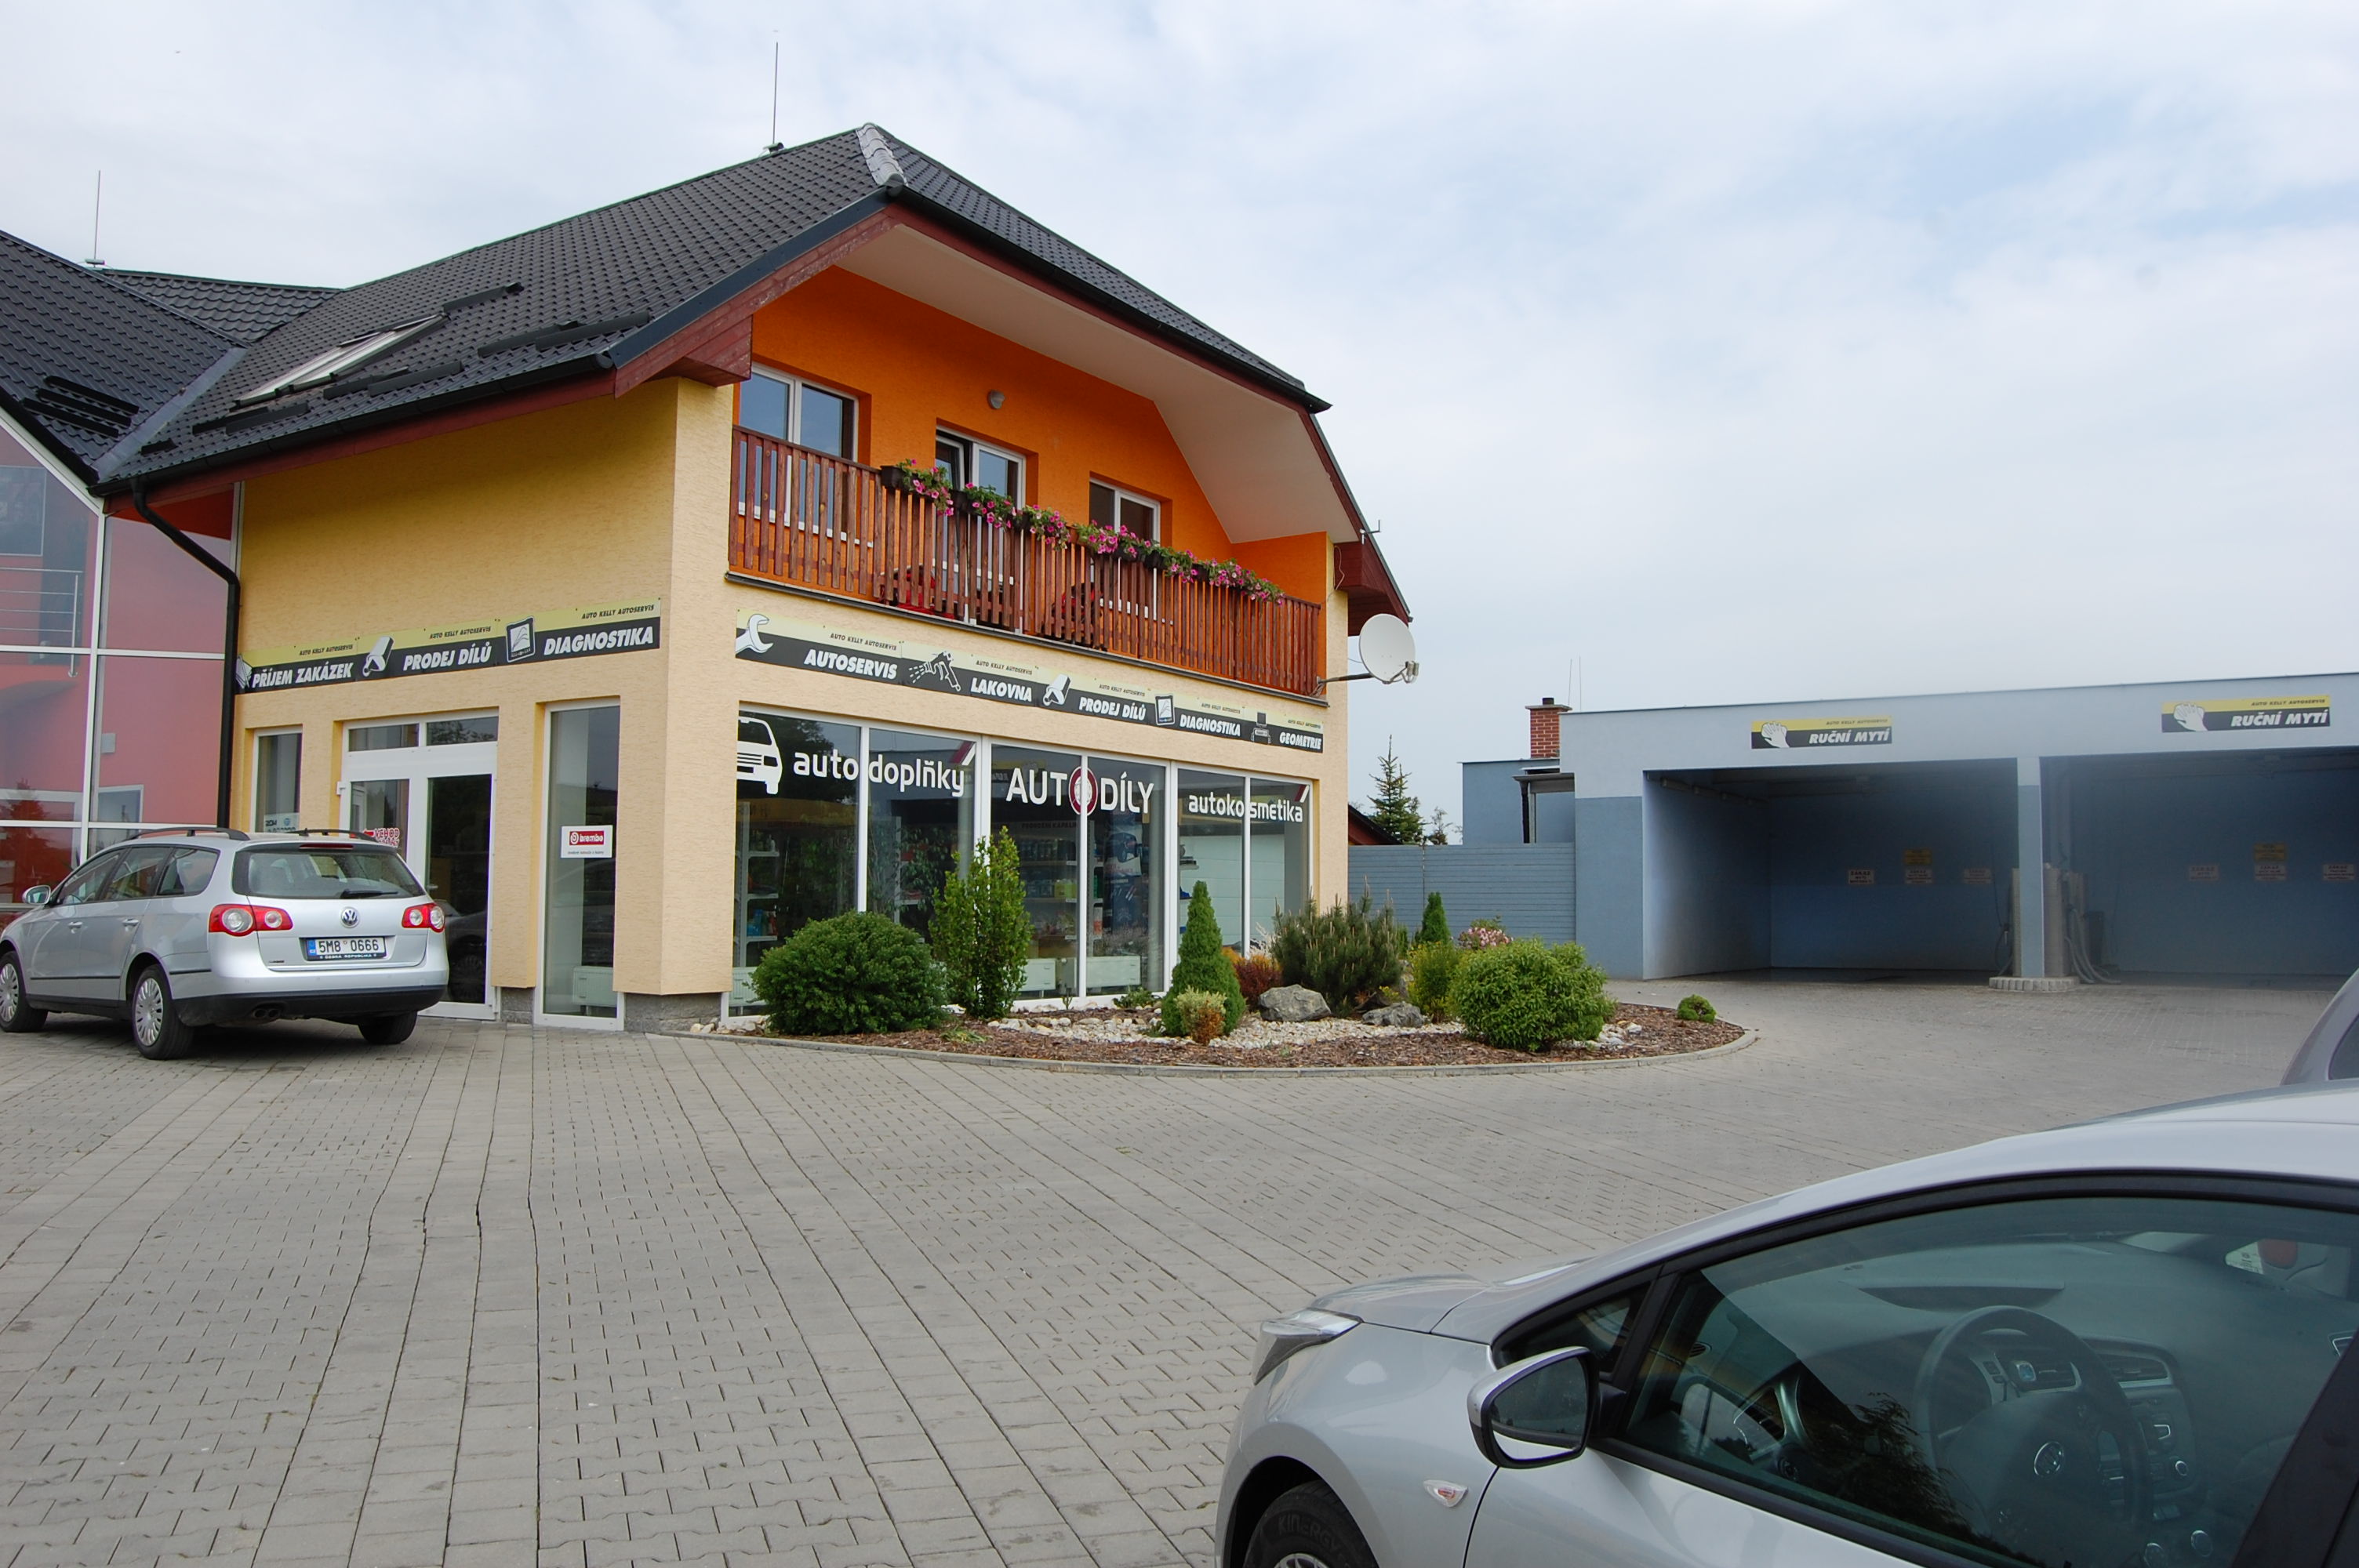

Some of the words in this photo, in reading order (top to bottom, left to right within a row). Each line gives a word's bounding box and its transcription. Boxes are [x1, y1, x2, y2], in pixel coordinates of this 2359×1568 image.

[617, 604, 654, 615] AUTOSERVIS
[460, 626, 492, 635] AUTOSERVIS
[543, 626, 653, 655] DIAGNOSTIKA
[864, 640, 897, 651] AUTOSERVIS
[403, 650, 456, 671] PRODEJ
[458, 641, 492, 665] DÍLŮ
[804, 649, 897, 680] AUTOSERVIS
[252, 668, 293, 688] PŘÍJEM
[295, 661, 354, 684] ZAKÁZEK
[1006, 666, 1032, 675] AUTOSERVIS
[971, 677, 1032, 702] LAKOVNA
[1079, 697, 1121, 717] PRODEJ
[1122, 702, 1146, 720] DÍLŮ
[2231, 711, 2282, 727] RUČNÍ
[2285, 709, 2328, 725] MYTÍ
[1180, 714, 1241, 736] DIAGNOSTIKA
[1279, 731, 1322, 750] GEOMETRIE
[1808, 730, 1851, 744] RUČNÍ
[1854, 728, 1891, 742] MYTÍ
[1189, 791, 1303, 822] autokosmetika
[375, 828, 399, 838] VCHOD
[318, 941, 341, 953] 5M8
[351, 939, 379, 952] 0666
